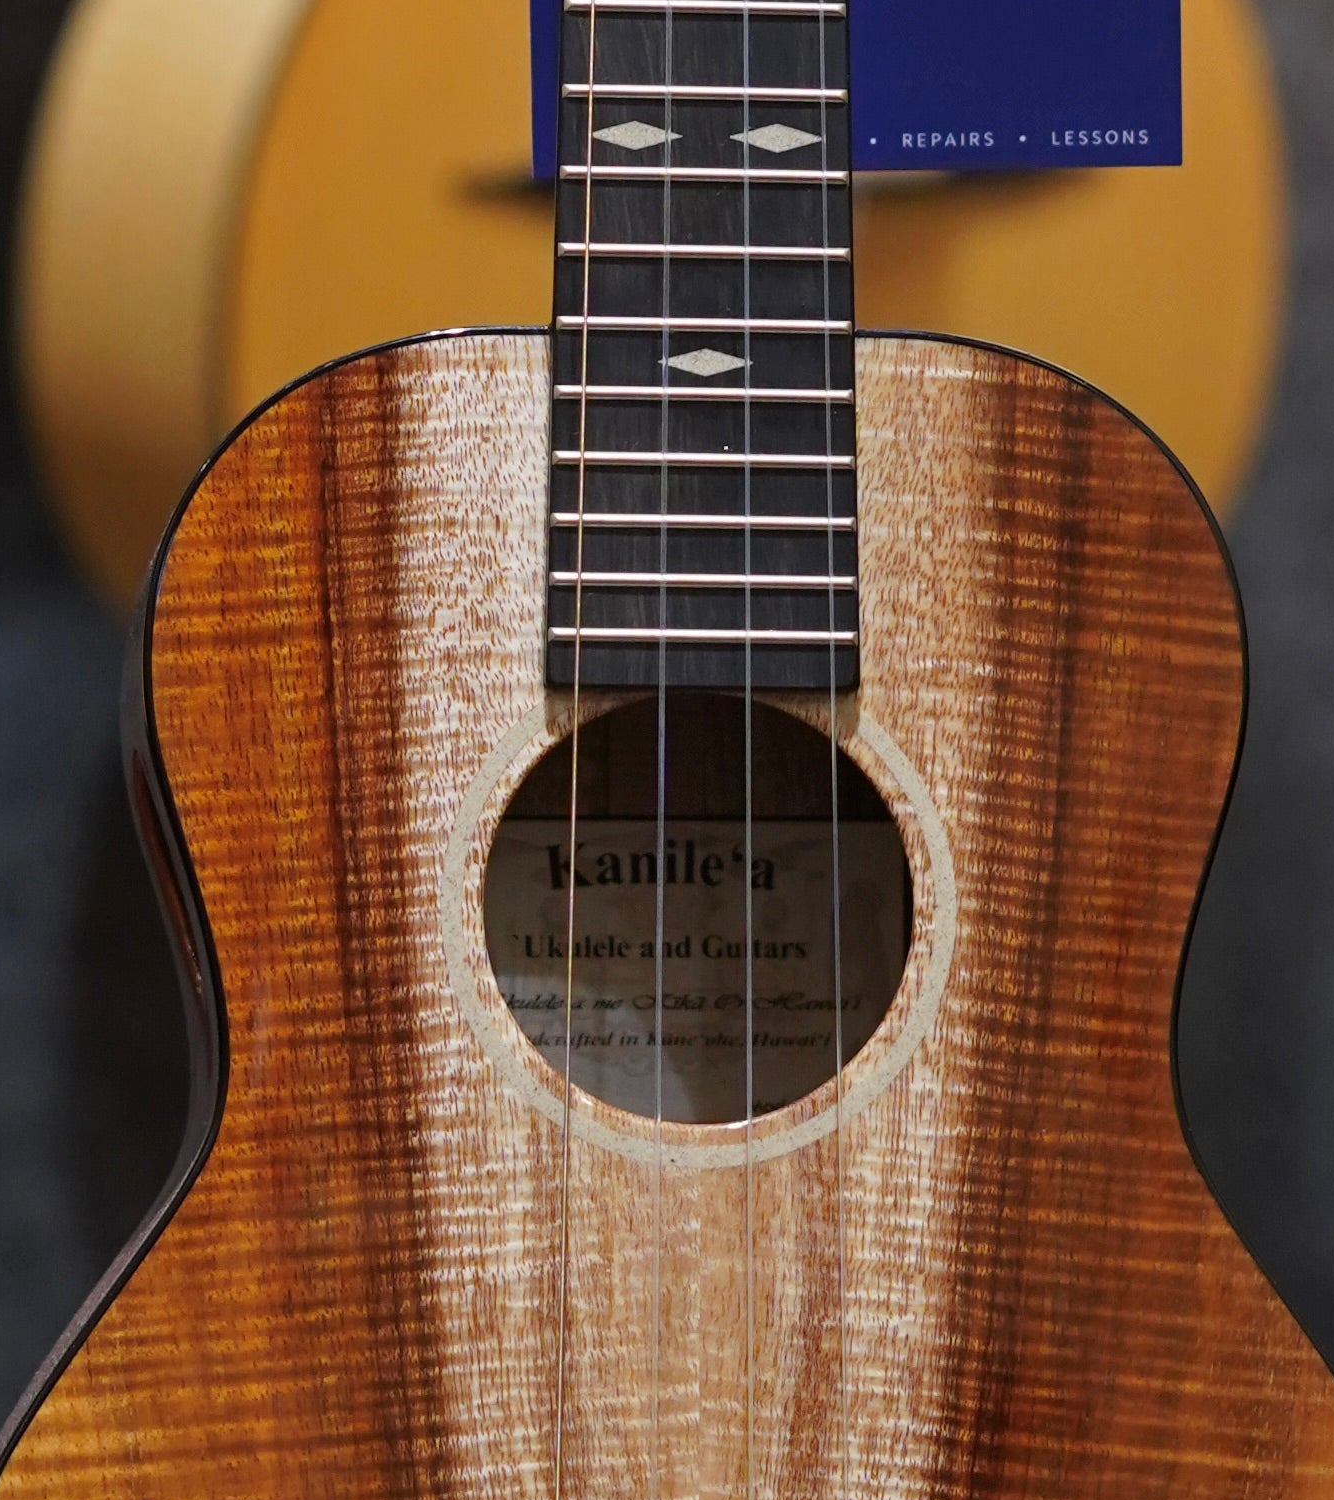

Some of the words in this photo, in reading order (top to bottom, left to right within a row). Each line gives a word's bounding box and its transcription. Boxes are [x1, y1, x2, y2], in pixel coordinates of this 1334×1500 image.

[902, 131, 996, 148] REPAIRS
[1051, 129, 1150, 146] LESSONS
[639, 935, 692, 959] and
